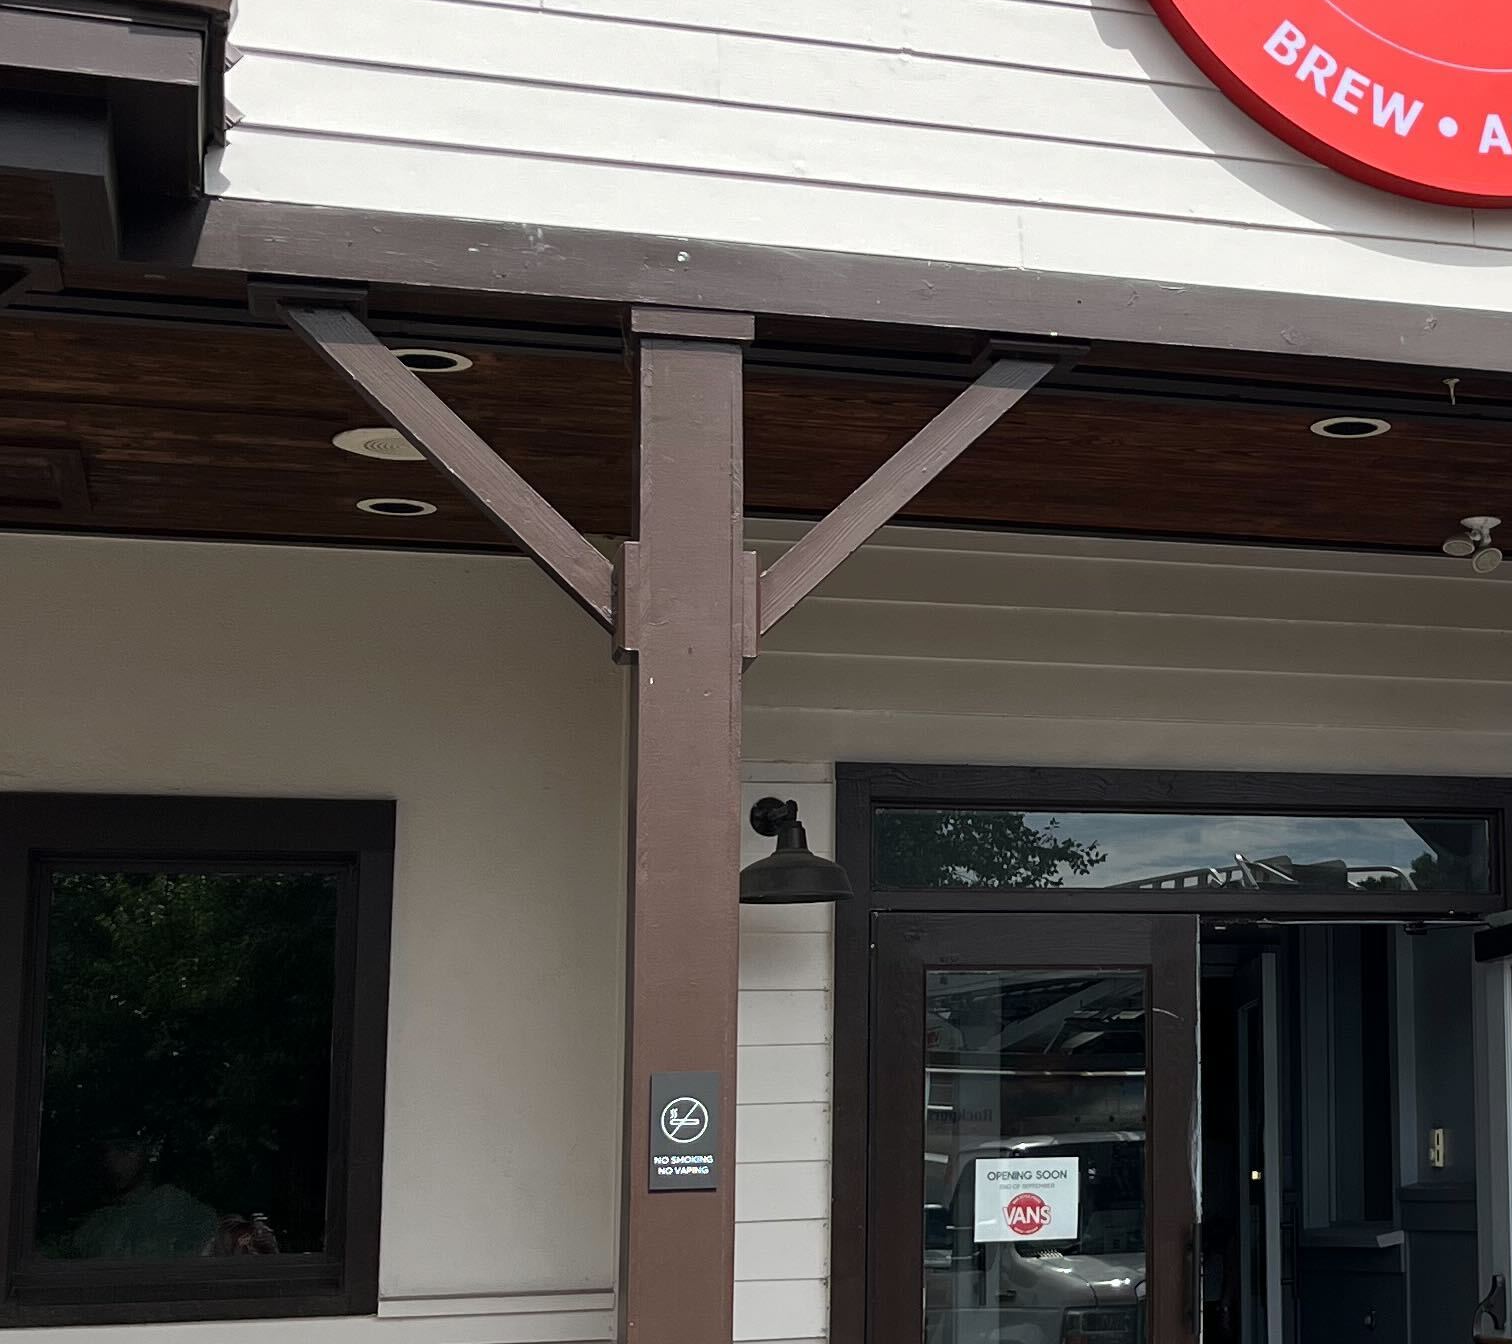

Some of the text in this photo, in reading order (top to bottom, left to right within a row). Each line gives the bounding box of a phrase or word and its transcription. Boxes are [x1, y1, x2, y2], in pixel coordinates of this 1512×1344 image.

[1262, 19, 1424, 137] BREW
[654, 1155, 714, 1164] NO SMOKING
[658, 1166, 709, 1175] NO VAPING
[987, 1170, 1067, 1181] OPENING SOON
[1003, 1205, 1050, 1225] VANS
